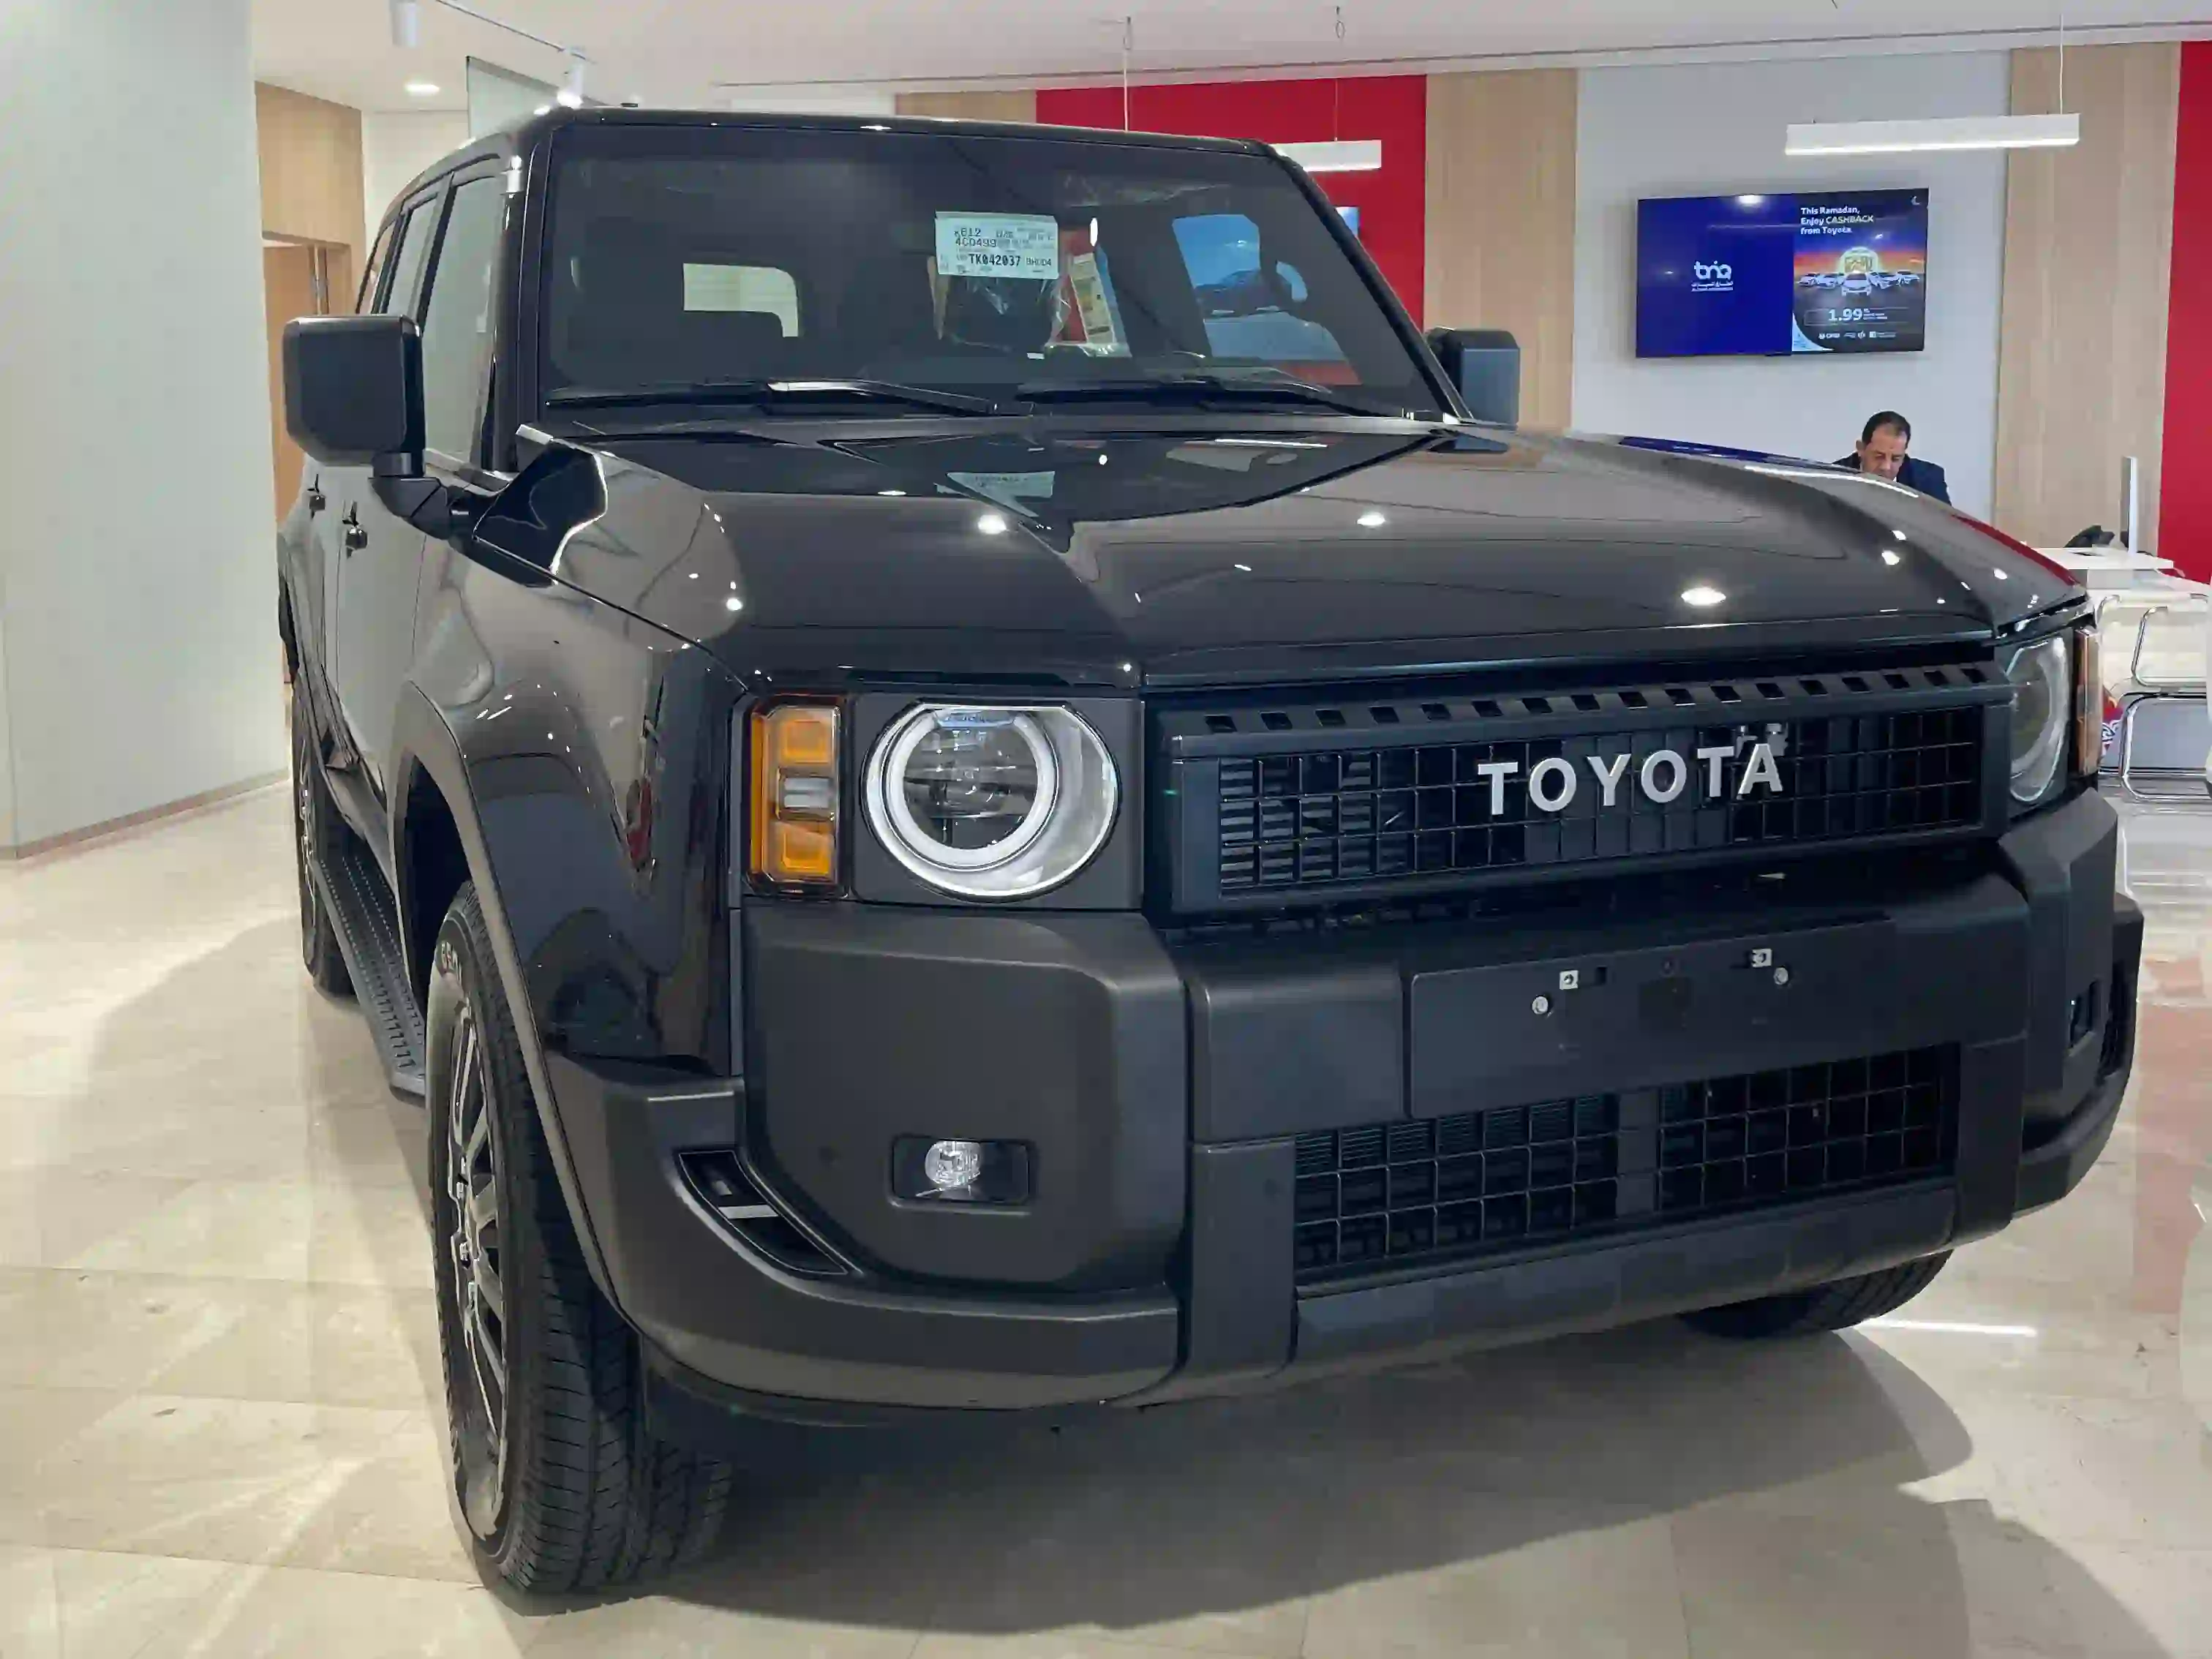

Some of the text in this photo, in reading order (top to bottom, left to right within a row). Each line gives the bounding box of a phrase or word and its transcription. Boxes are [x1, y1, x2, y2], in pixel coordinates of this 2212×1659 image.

[1820, 206, 1860, 214] Ramadan,
[1800, 215, 1874, 226] Enjoy CASHBACK
[1822, 226, 1852, 236] Toyota
[968, 253, 1021, 266] TK042037
[1478, 742, 1783, 816] TOYOTA
